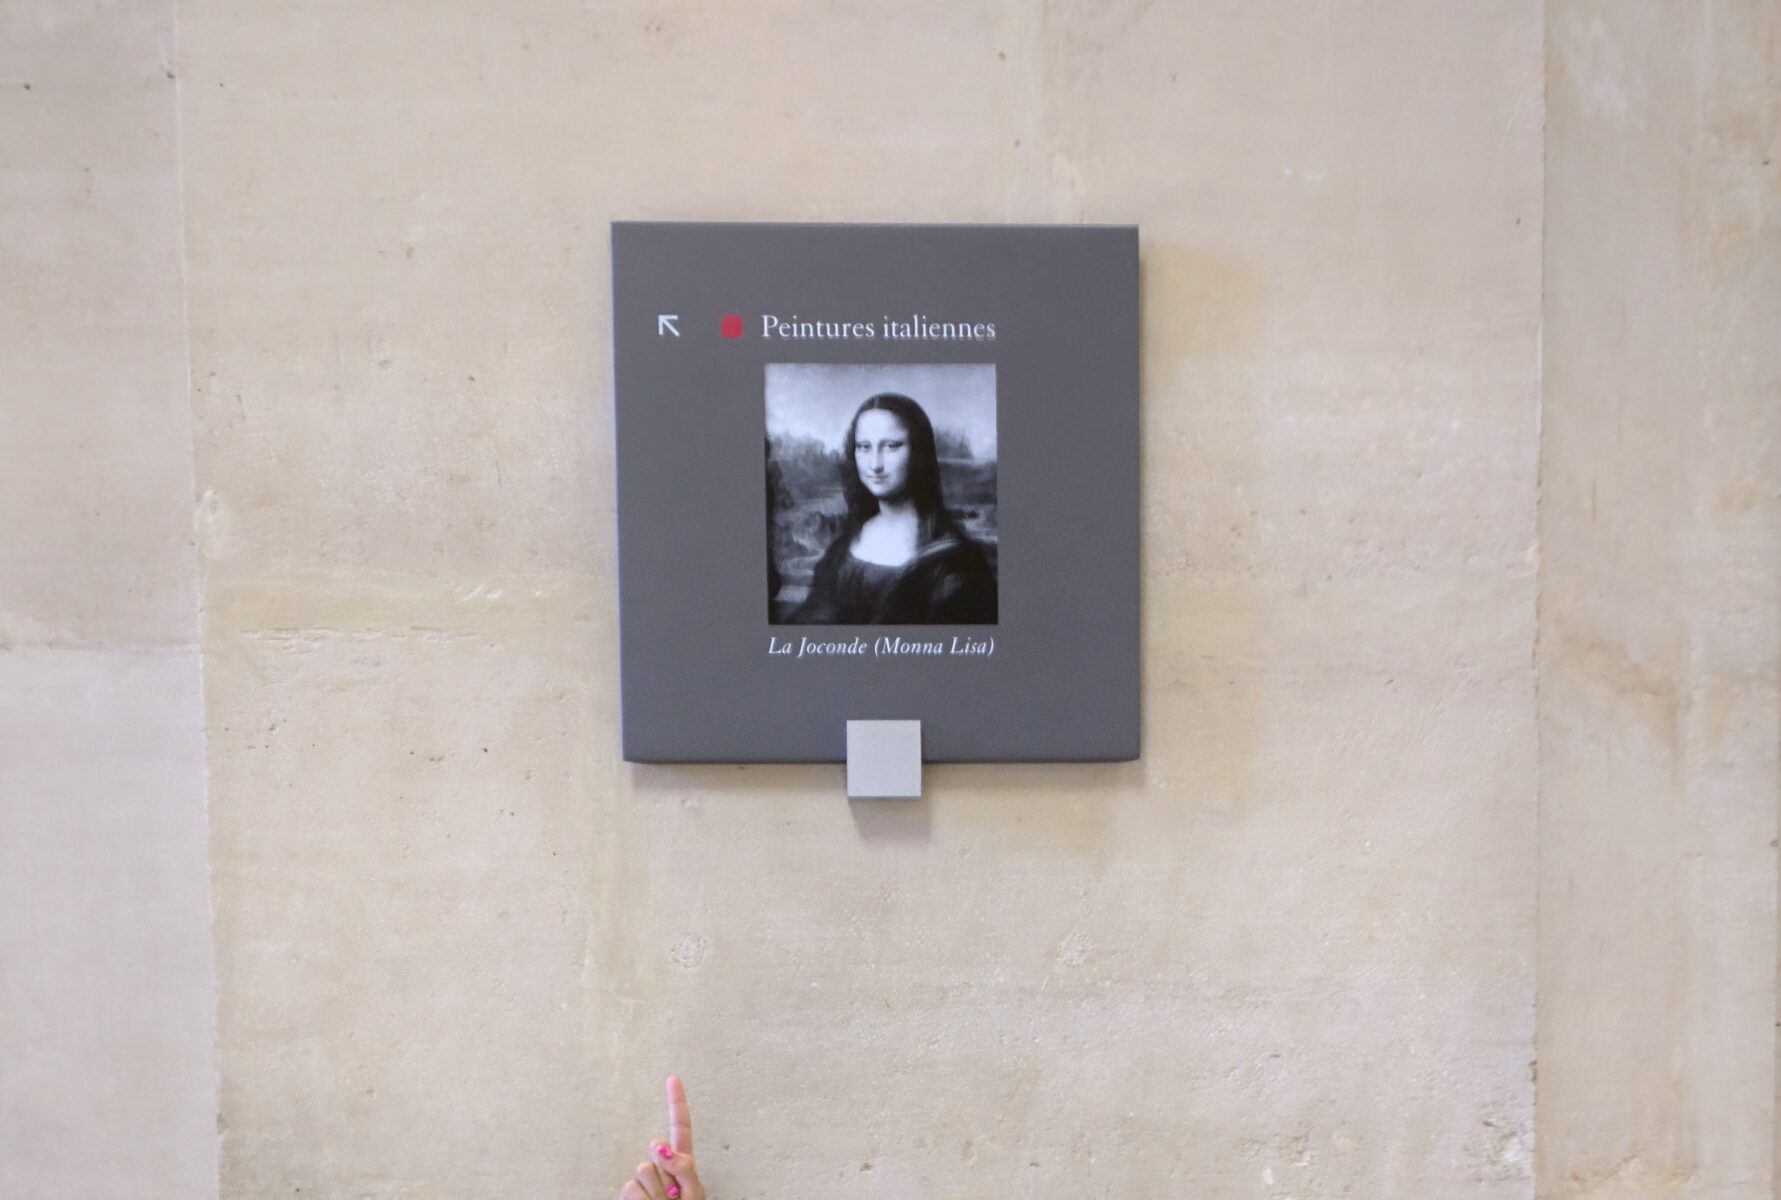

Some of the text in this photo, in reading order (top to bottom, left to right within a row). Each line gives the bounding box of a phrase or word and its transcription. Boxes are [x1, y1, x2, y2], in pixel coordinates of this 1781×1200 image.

[761, 314, 997, 340] Peintures italiennes
[768, 636, 995, 658] La Joconde (Monna Lisa)
